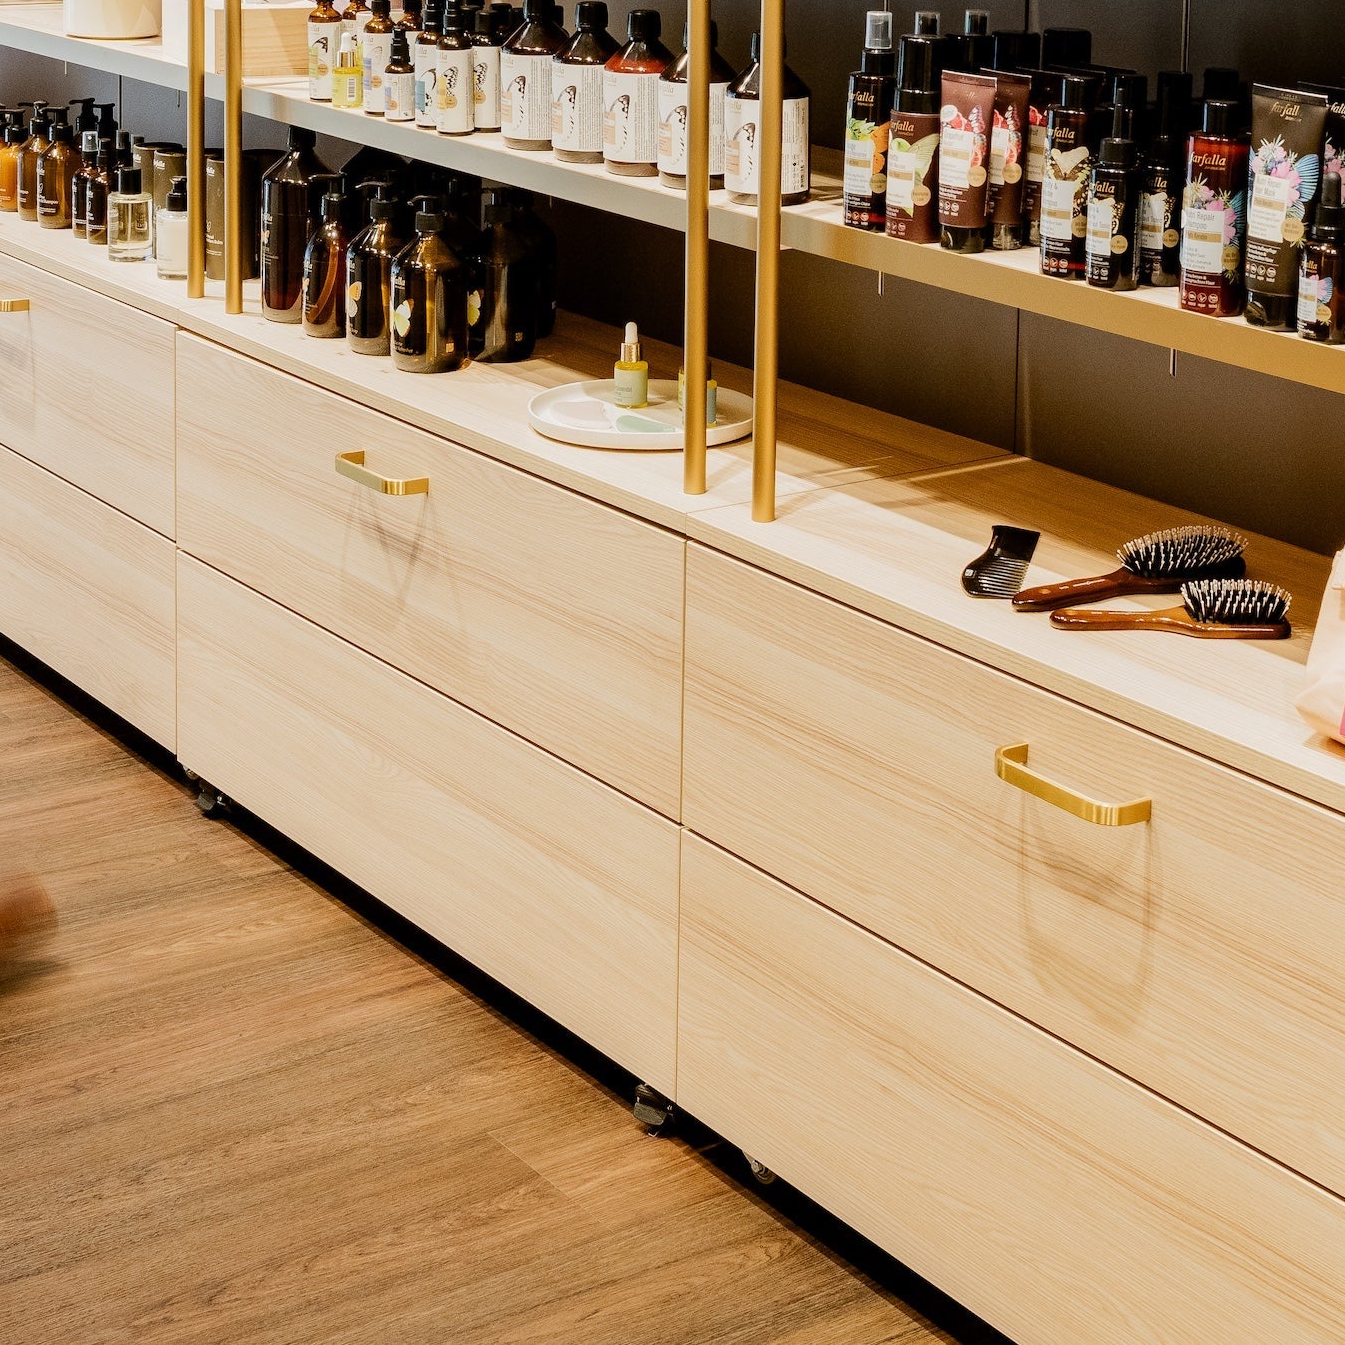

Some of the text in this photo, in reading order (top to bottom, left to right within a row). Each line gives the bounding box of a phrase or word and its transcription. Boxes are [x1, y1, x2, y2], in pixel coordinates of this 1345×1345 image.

[1270, 101, 1300, 118] farfall
[1190, 150, 1227, 167] farfalla
[1196, 211, 1215, 222] Repair
